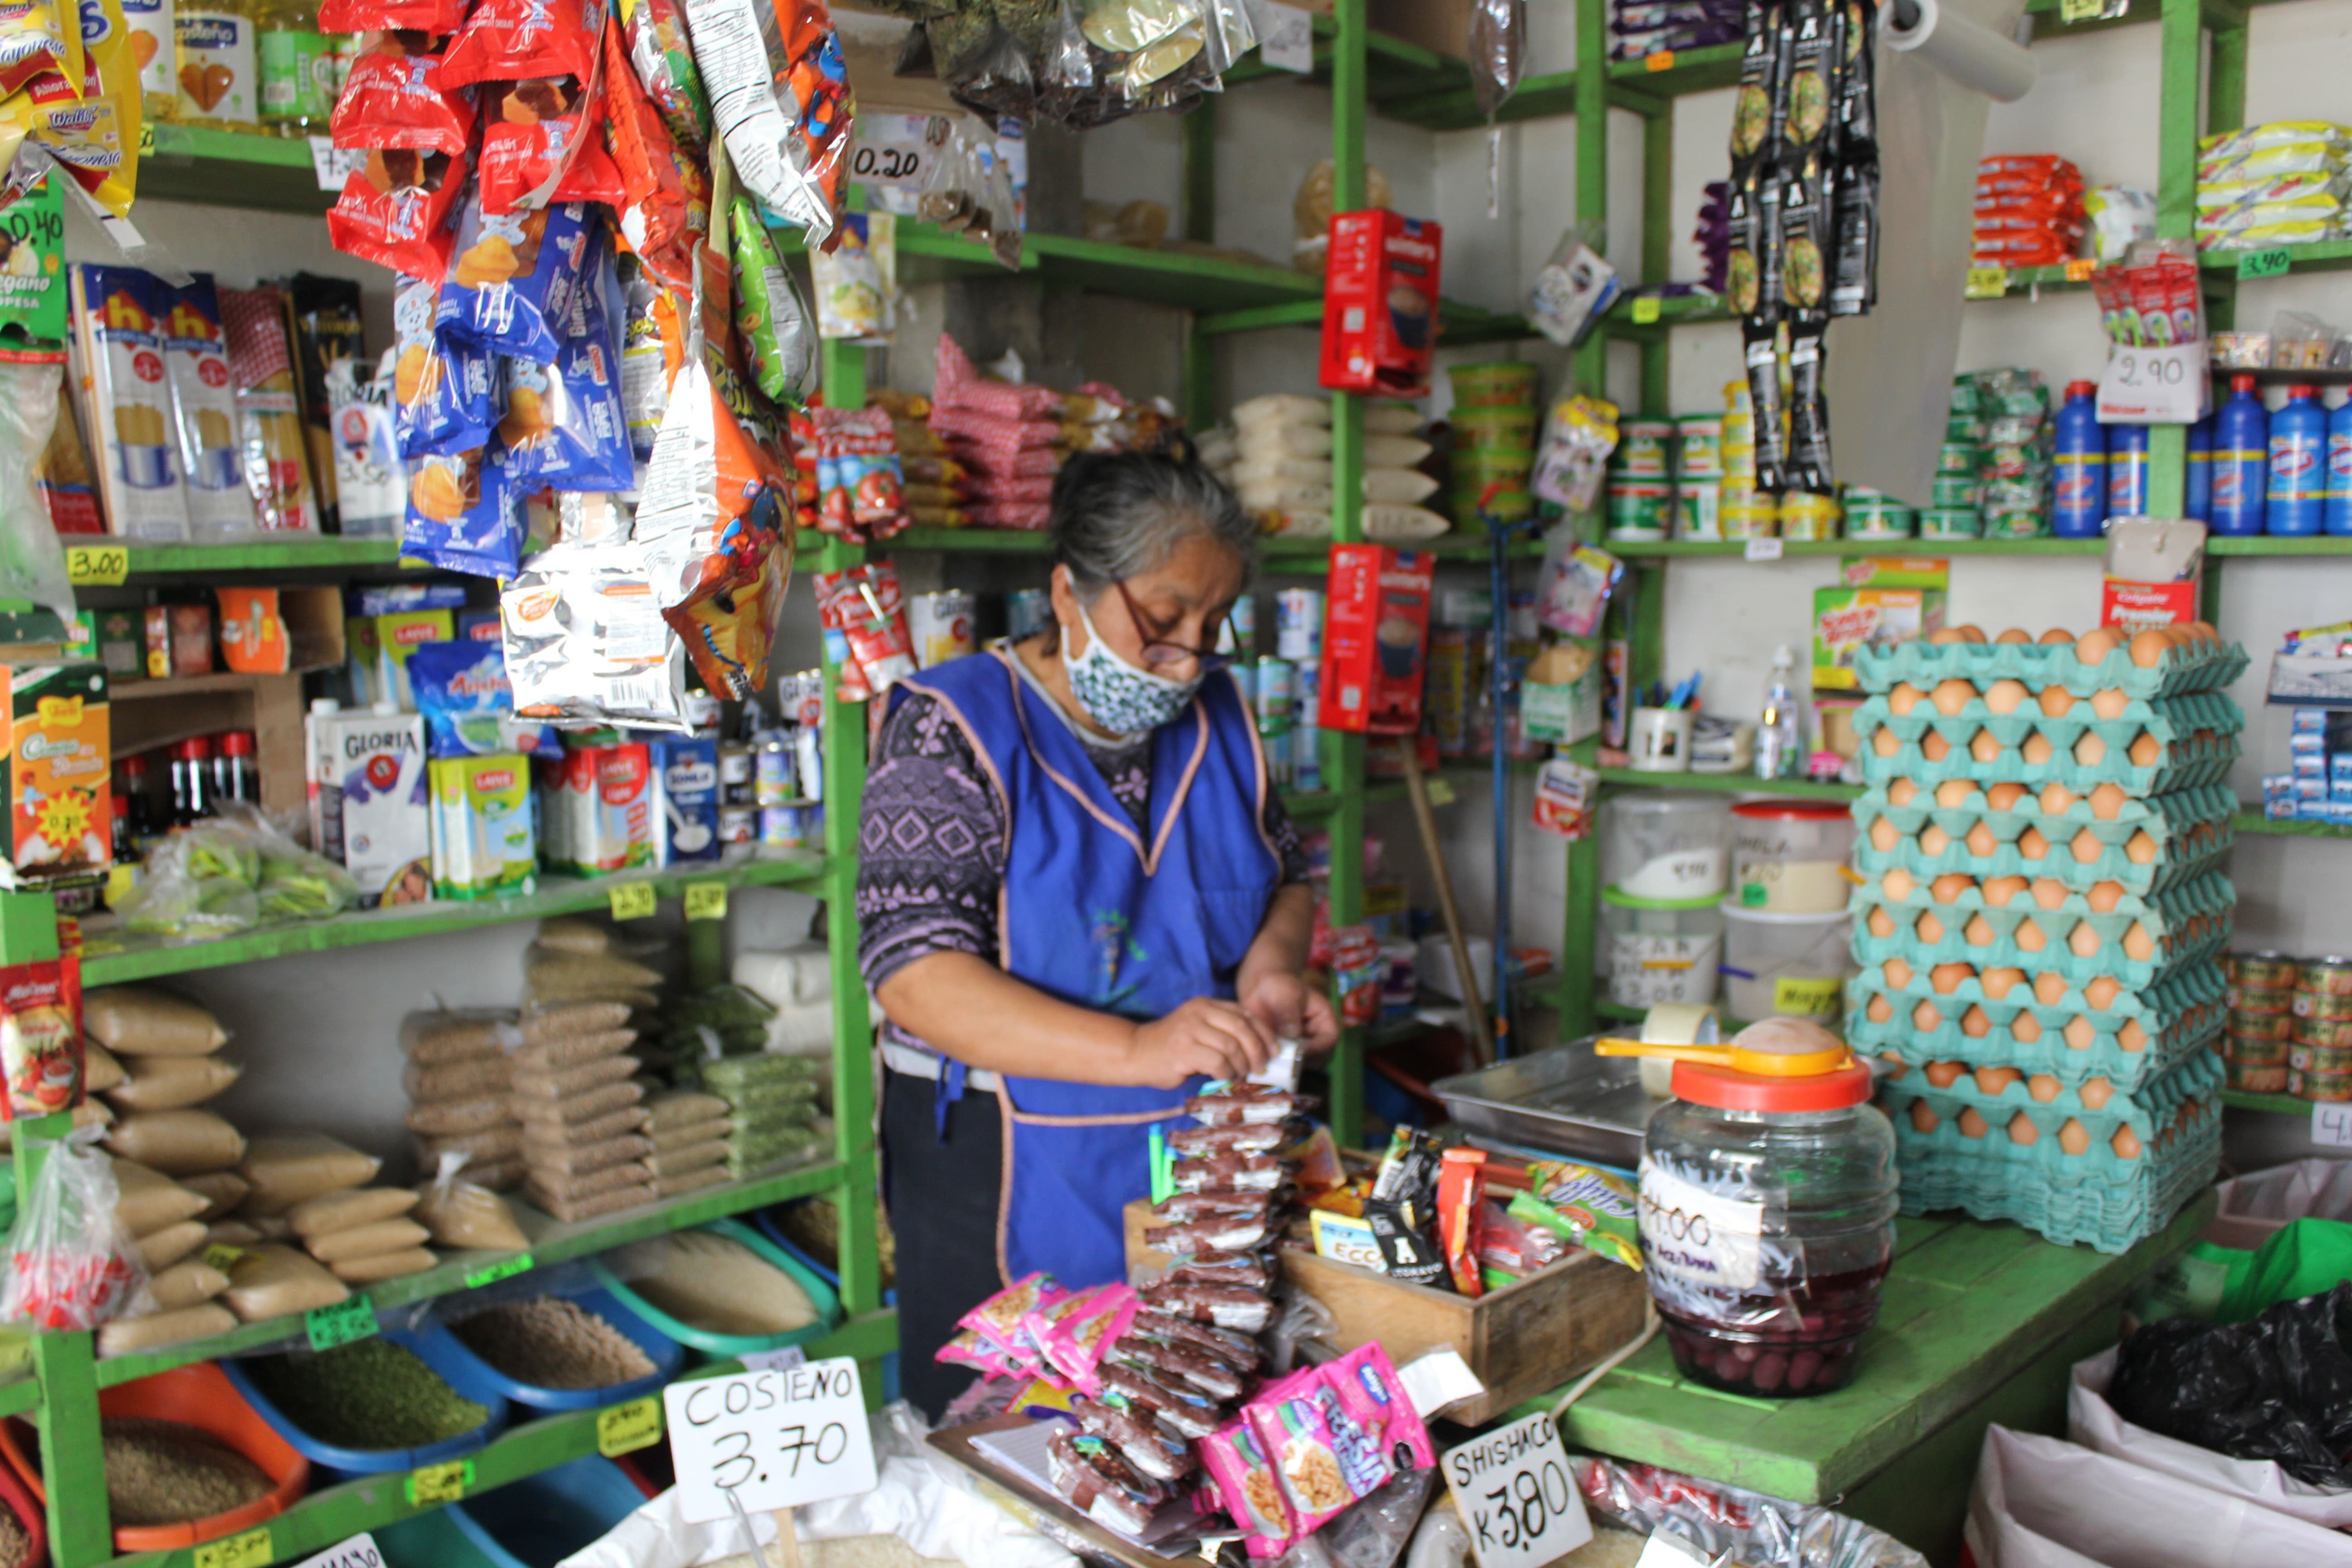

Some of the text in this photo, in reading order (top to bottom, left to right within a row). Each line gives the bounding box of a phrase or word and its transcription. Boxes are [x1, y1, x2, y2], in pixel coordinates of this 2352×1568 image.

[854, 148, 918, 178] 0.20
[10, 209, 63, 248] 0.40
[74, 552, 124, 577] 3.00
[2110, 606, 2176, 623] Premier
[346, 730, 418, 758] GLORIA
[685, 1363, 852, 1426] COSTEÑO
[712, 1421, 848, 1489] 3.70
[1453, 1416, 1553, 1487] SHISHACO
